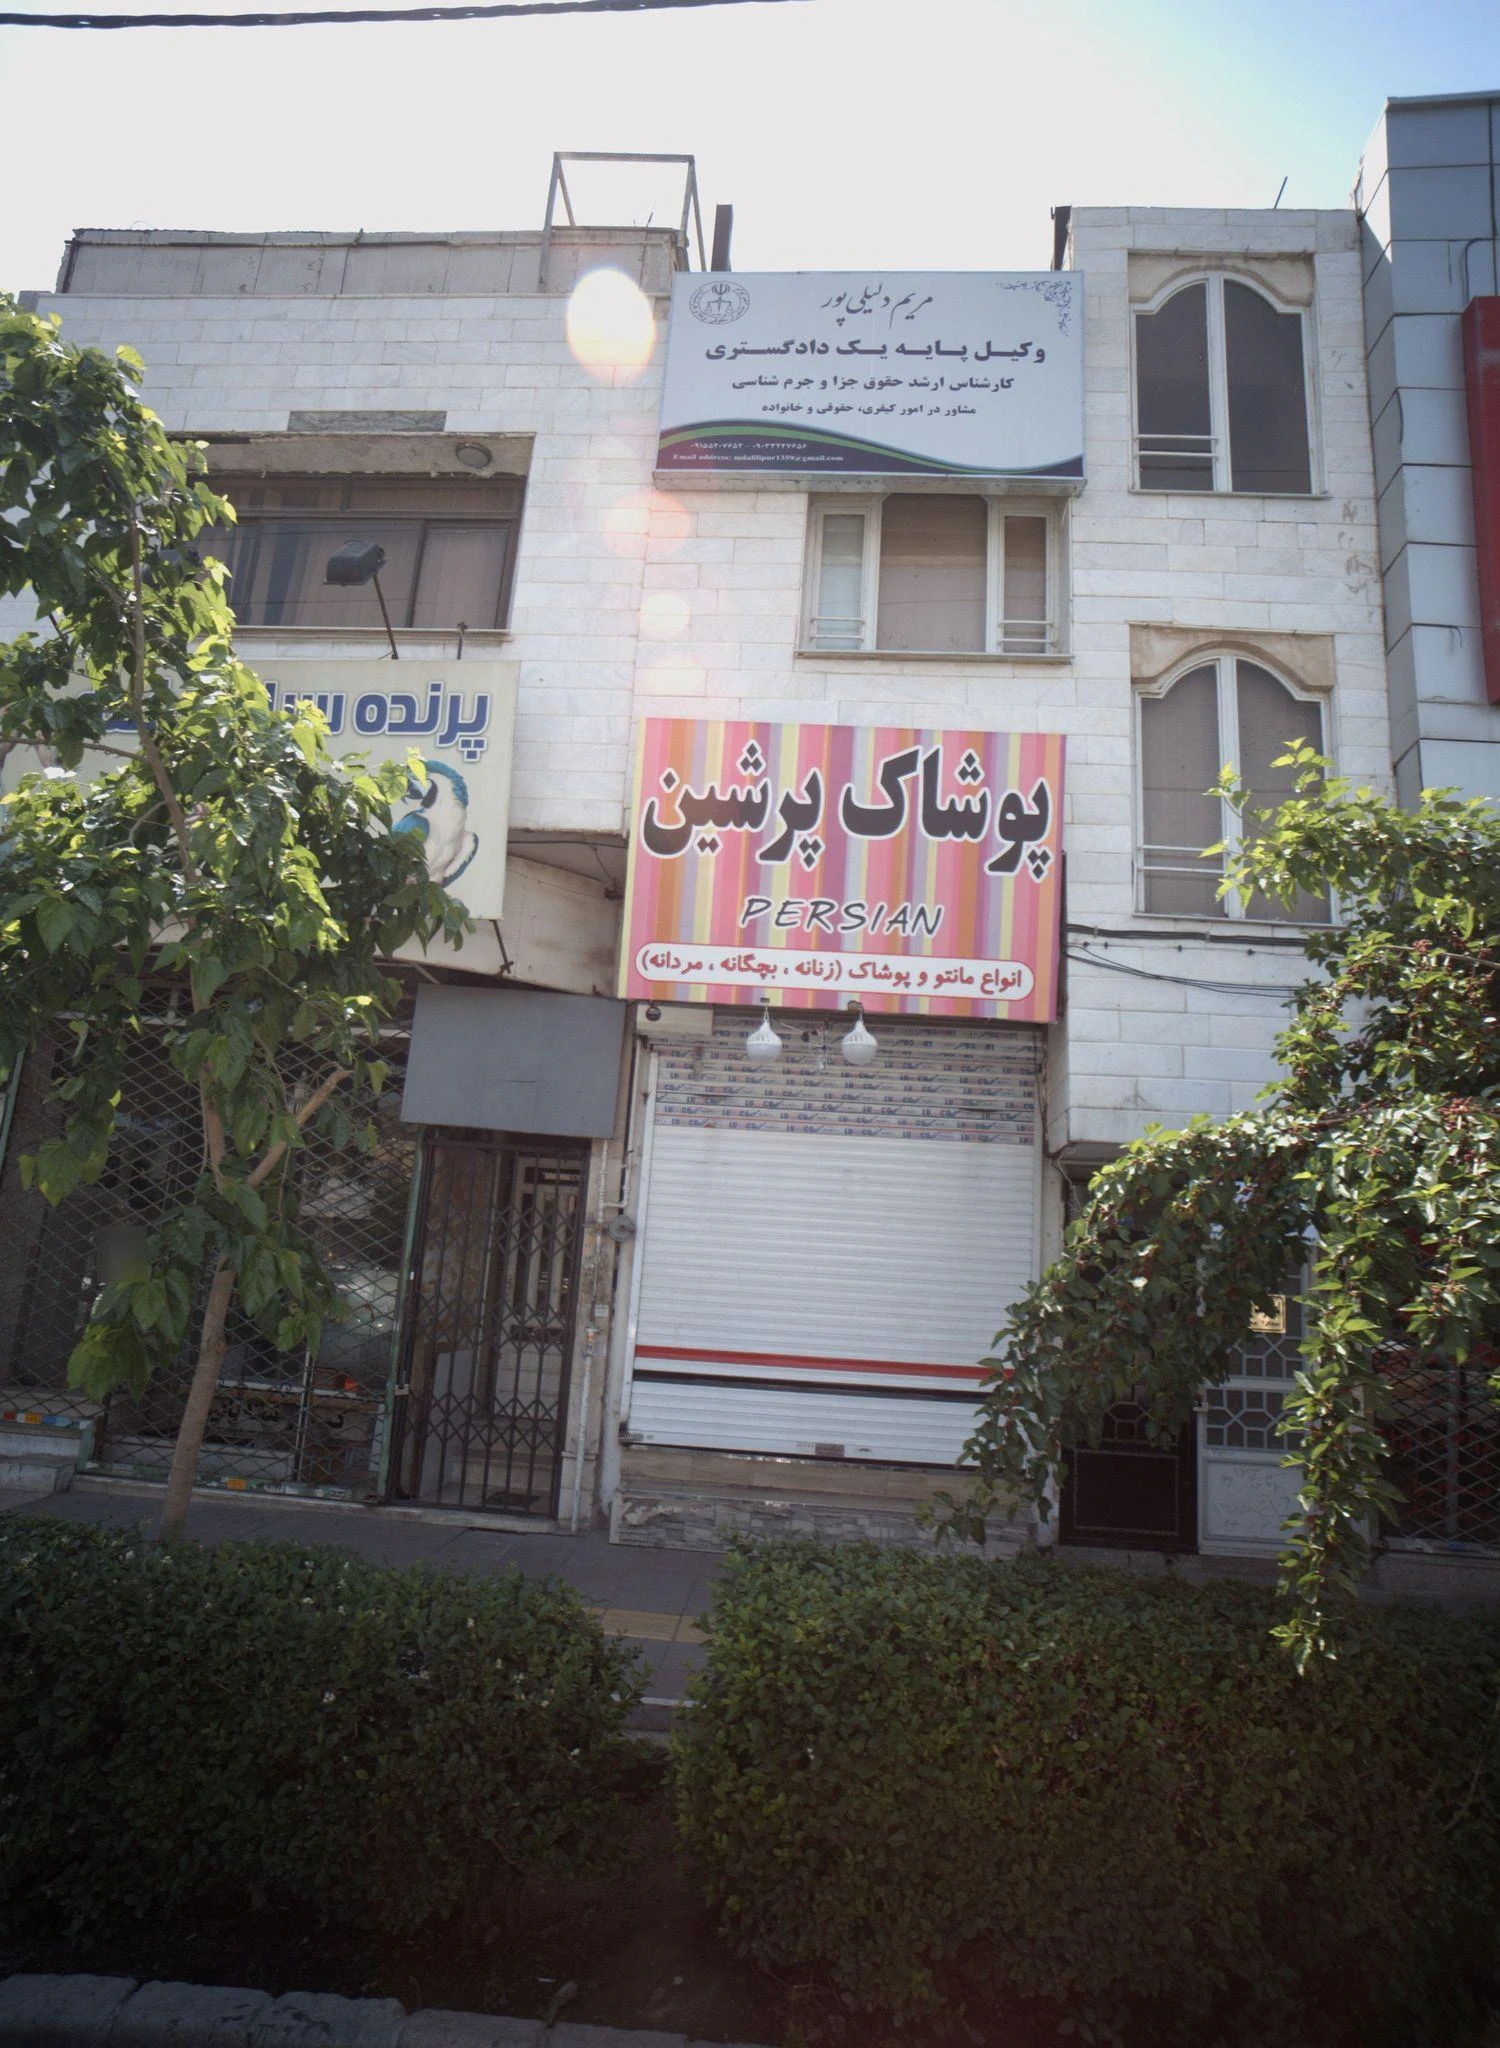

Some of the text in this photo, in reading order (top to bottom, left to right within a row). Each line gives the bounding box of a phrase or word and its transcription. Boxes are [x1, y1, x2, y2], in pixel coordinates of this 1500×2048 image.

[820, 291, 847, 327] پور
[889, 292, 934, 329] مریم
[705, 338, 1046, 363] وکیل پایه یک دادگستری
[731, 374, 1015, 392] کارشناس ارشد حقوق جزا و جرم شناسی
[761, 402, 803, 415] خانواده
[816, 402, 854, 416] حقوقی
[900, 403, 924, 416] امور
[927, 406, 941, 417] در
[944, 405, 977, 417] مشاور
[354, 681, 491, 761] پرنده
[641, 739, 1053, 882] پوشاک پرشین
[739, 896, 943, 937] PERSIAN
[720, 953, 778, 980] بچگانه
[848, 961, 910, 988] پوشاک
[917, 971, 928, 987] و
[933, 966, 975, 989] مانتو
[980, 969, 1022, 995] انواع
